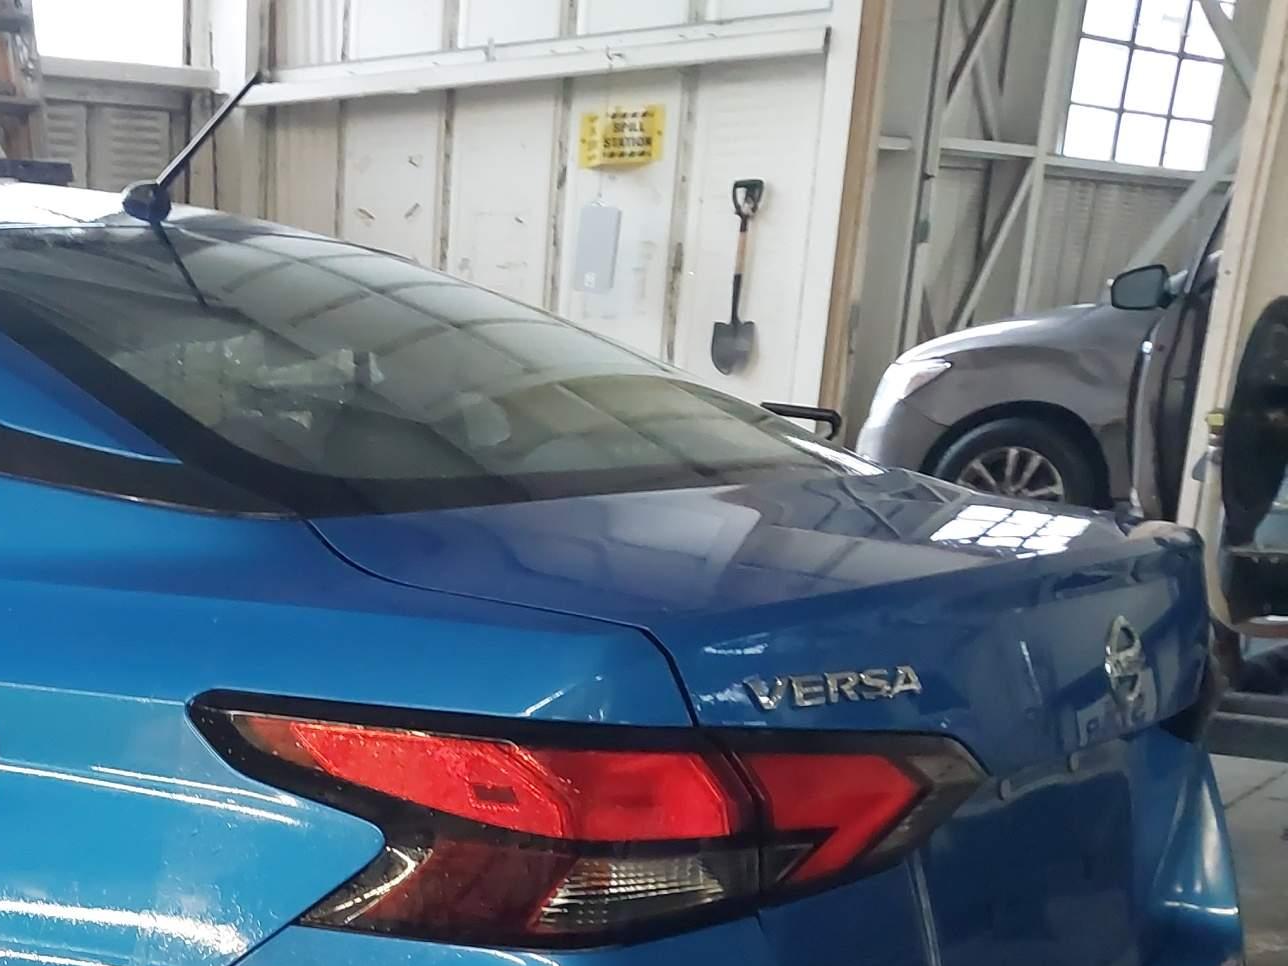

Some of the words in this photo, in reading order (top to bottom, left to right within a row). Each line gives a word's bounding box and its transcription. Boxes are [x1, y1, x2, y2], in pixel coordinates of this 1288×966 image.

[613, 120, 645, 133] SPILL
[603, 136, 653, 149] STATION
[742, 665, 922, 710] VERSA
